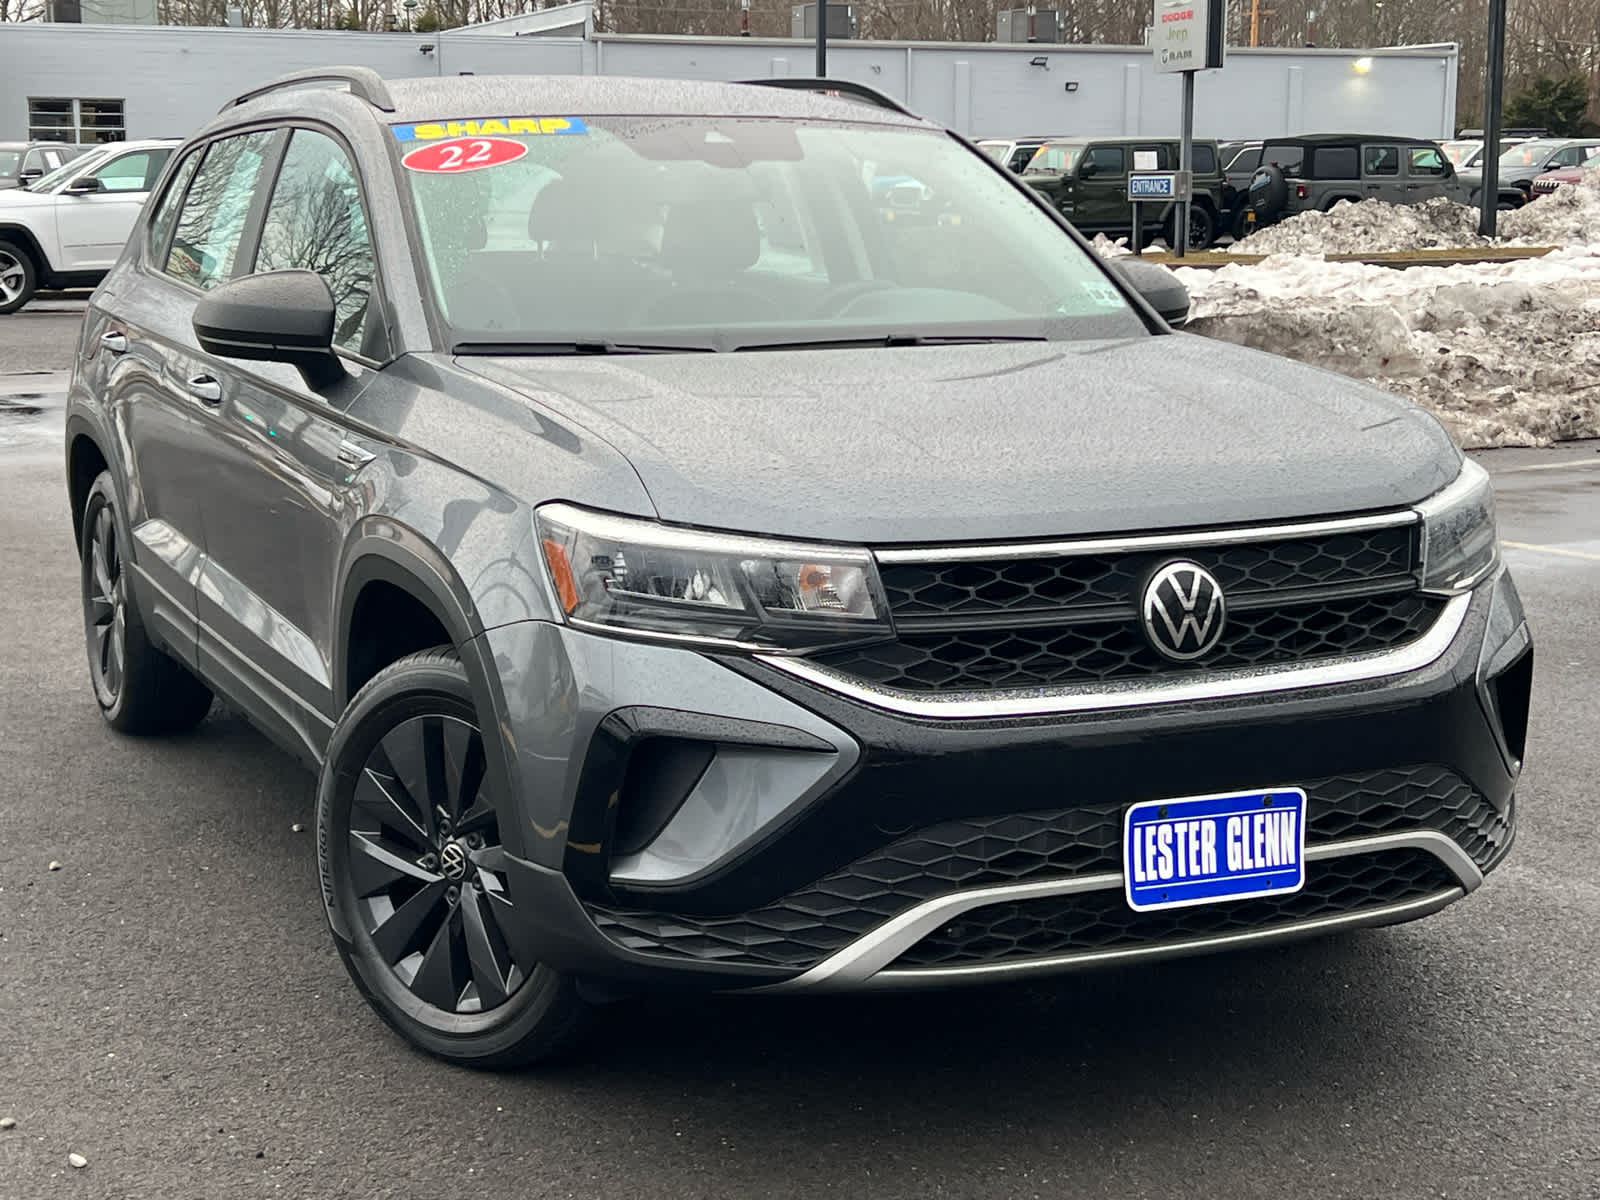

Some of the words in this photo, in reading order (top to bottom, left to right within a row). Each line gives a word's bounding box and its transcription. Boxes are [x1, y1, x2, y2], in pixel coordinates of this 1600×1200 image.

[1162, 10, 1193, 23] DODGE
[1169, 50, 1192, 60] RAM
[414, 117, 571, 140] SHARP
[438, 141, 493, 169] 22
[1132, 180, 1169, 194] ENTRANCE
[1133, 819, 1217, 882] LESTER
[1226, 811, 1297, 872] GLENN
